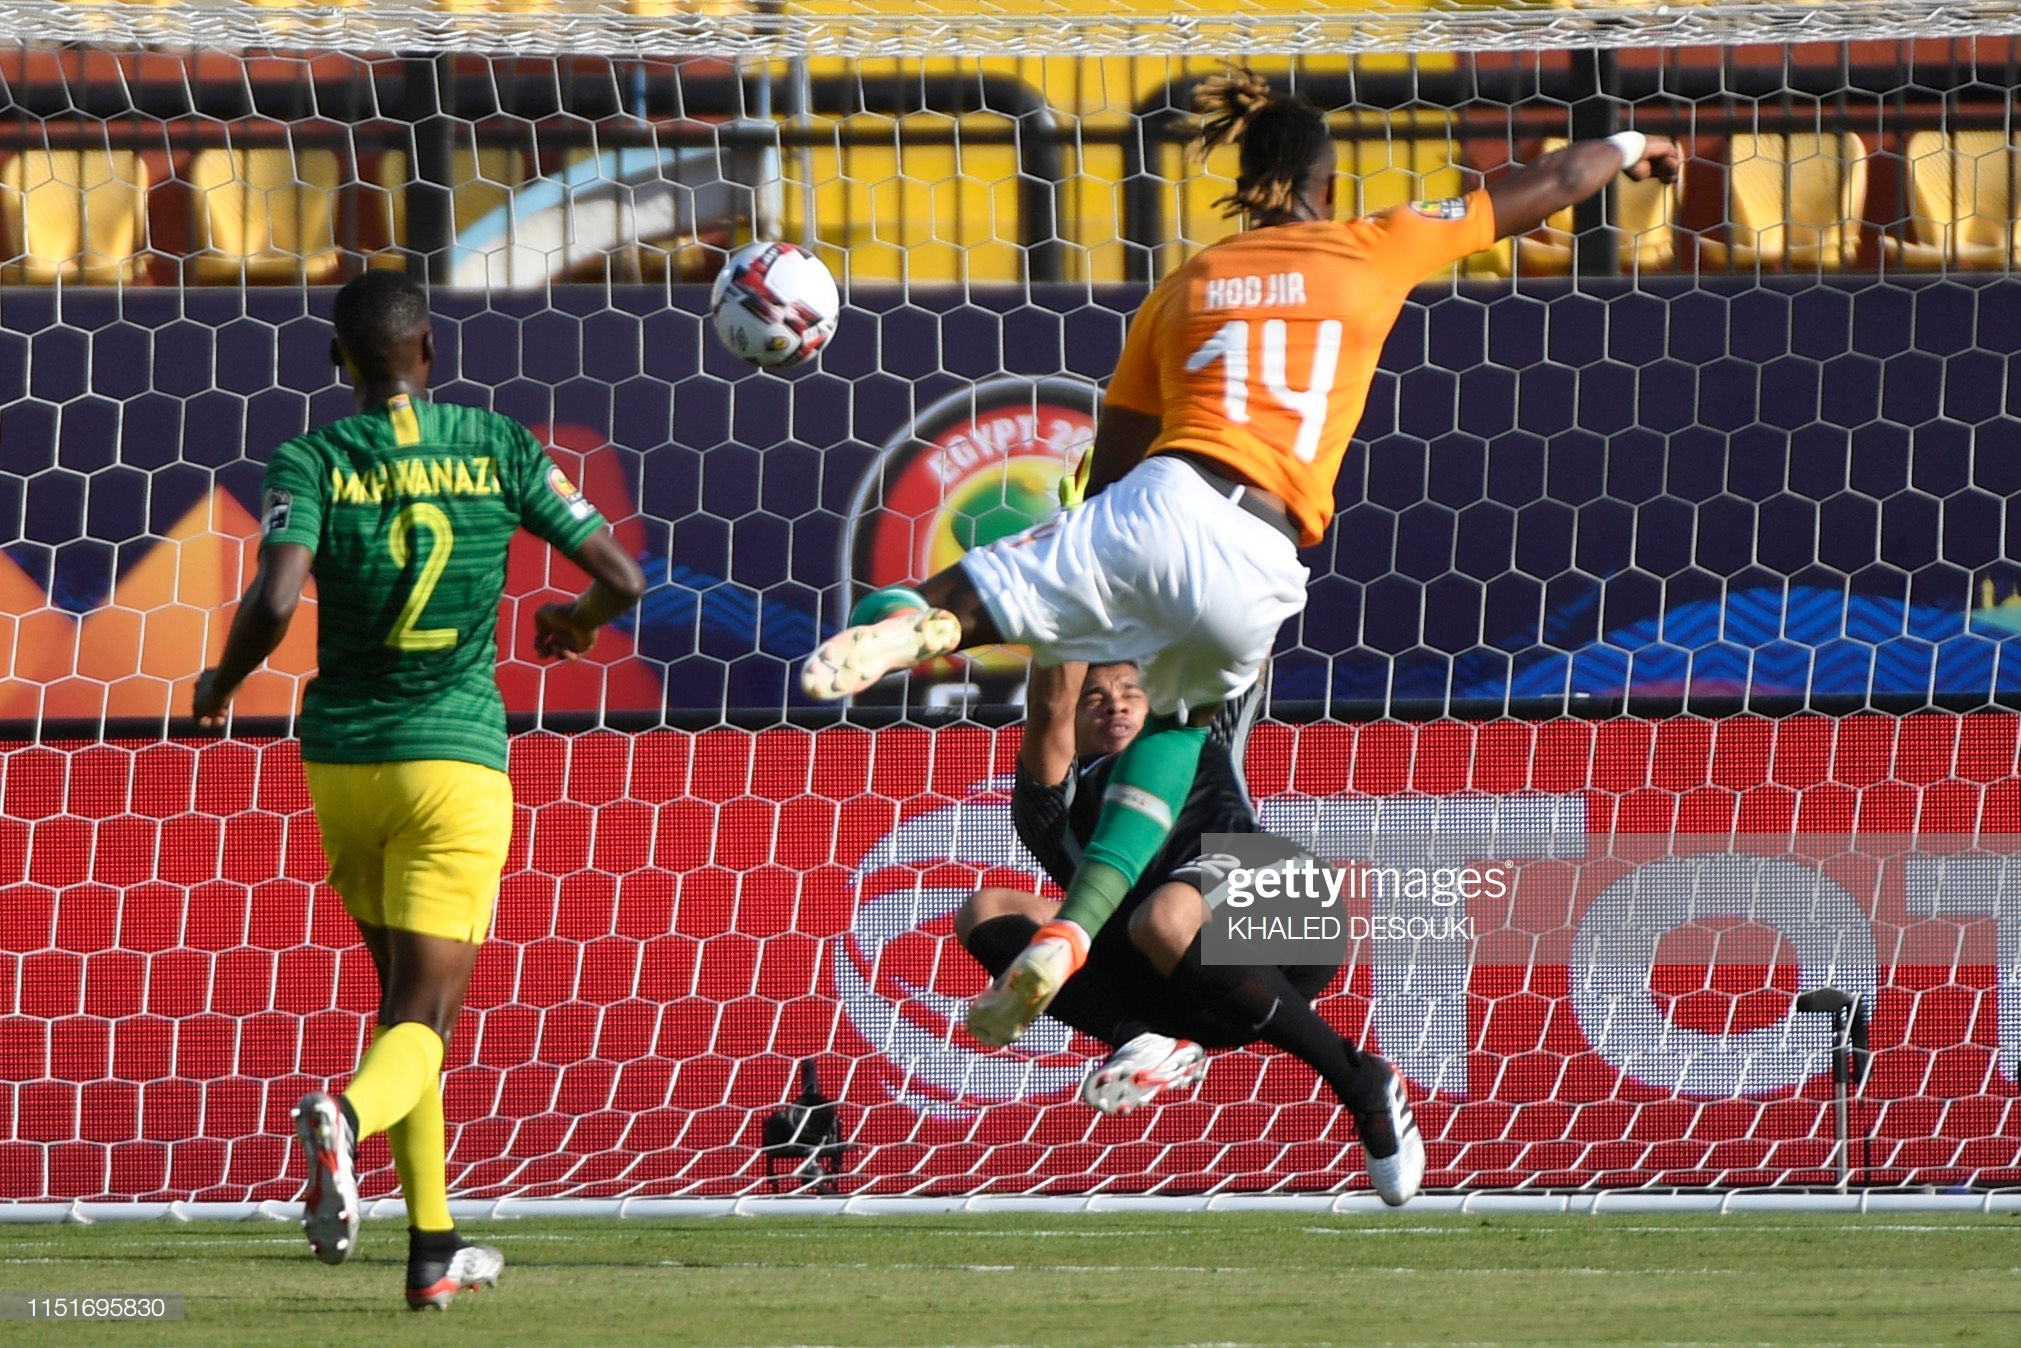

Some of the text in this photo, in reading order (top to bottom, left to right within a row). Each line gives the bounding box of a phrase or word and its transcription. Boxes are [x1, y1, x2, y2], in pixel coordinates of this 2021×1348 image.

[927, 414, 1095, 483] EGYPT 20
[1185, 318, 1343, 463] 14
[385, 502, 459, 651] 2
